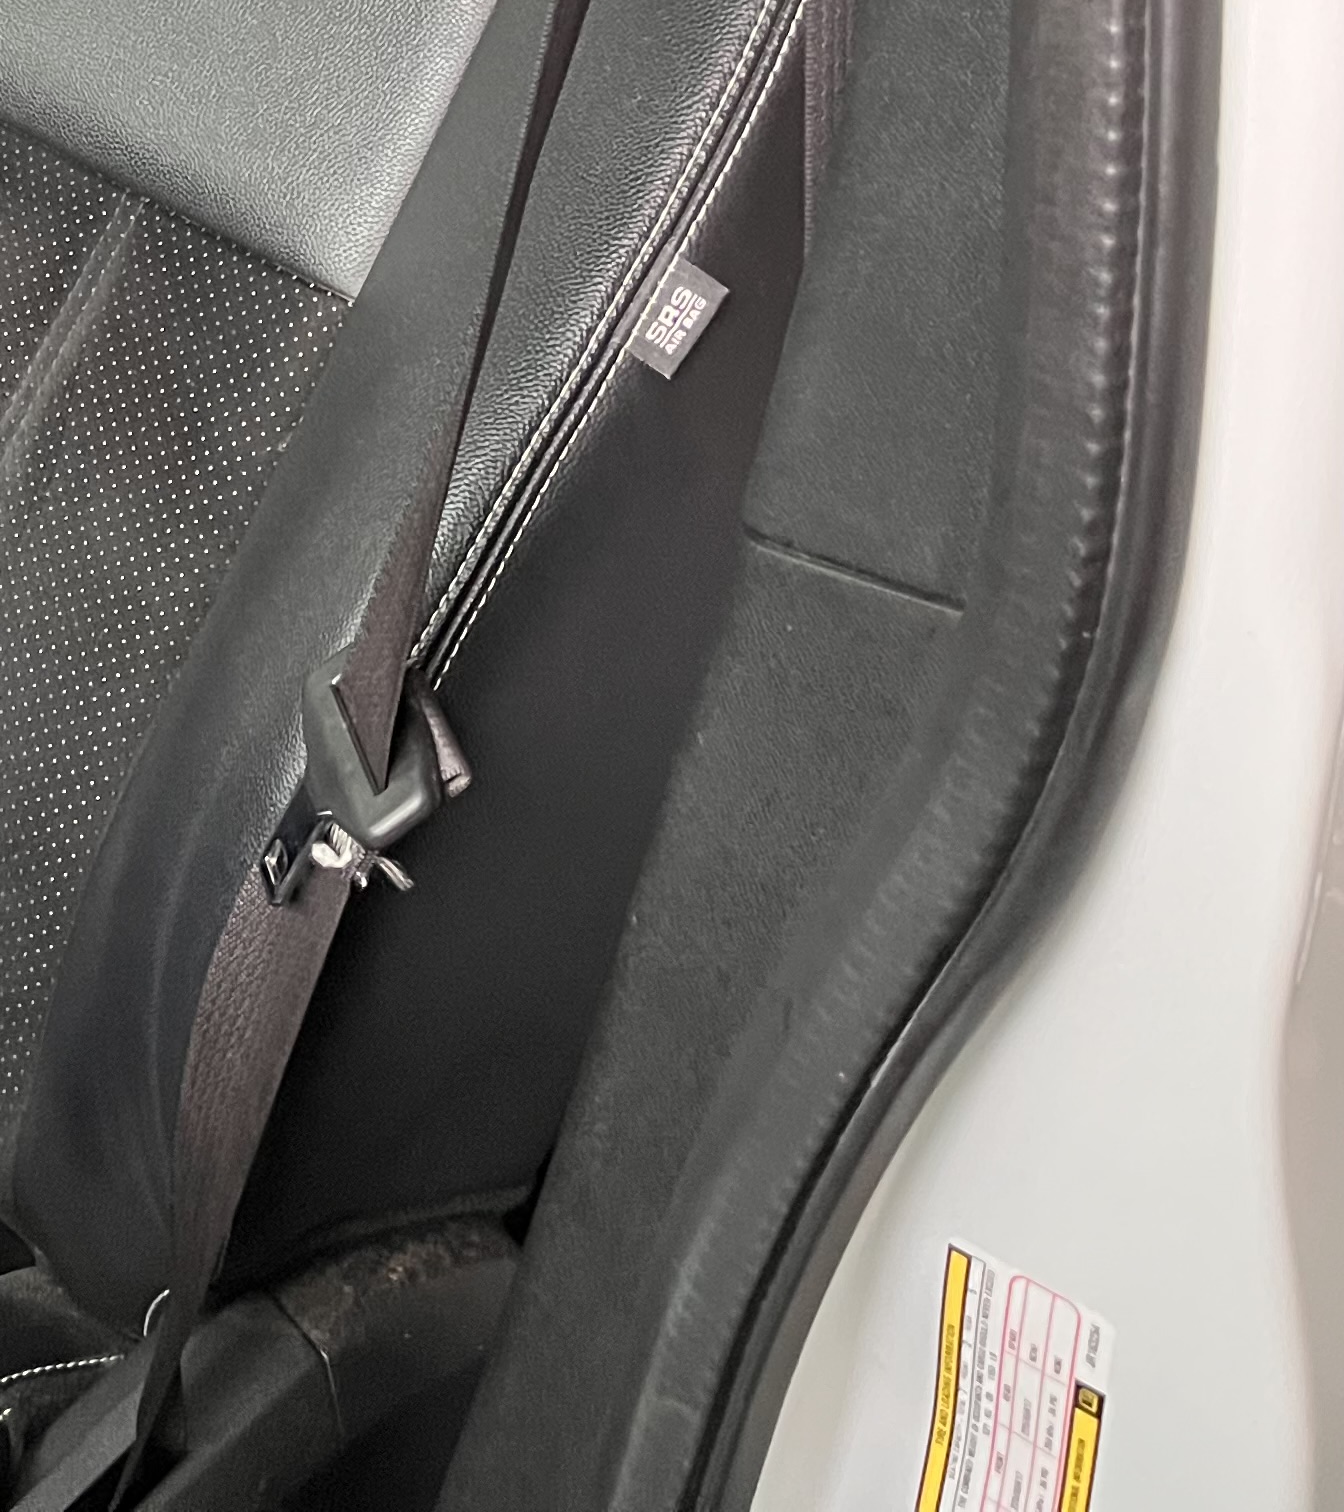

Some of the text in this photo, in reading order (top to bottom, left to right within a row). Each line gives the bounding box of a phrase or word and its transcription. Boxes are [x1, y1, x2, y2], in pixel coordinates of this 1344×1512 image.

[645, 286, 693, 343] SRS
[664, 296, 707, 355] AIR BAG
